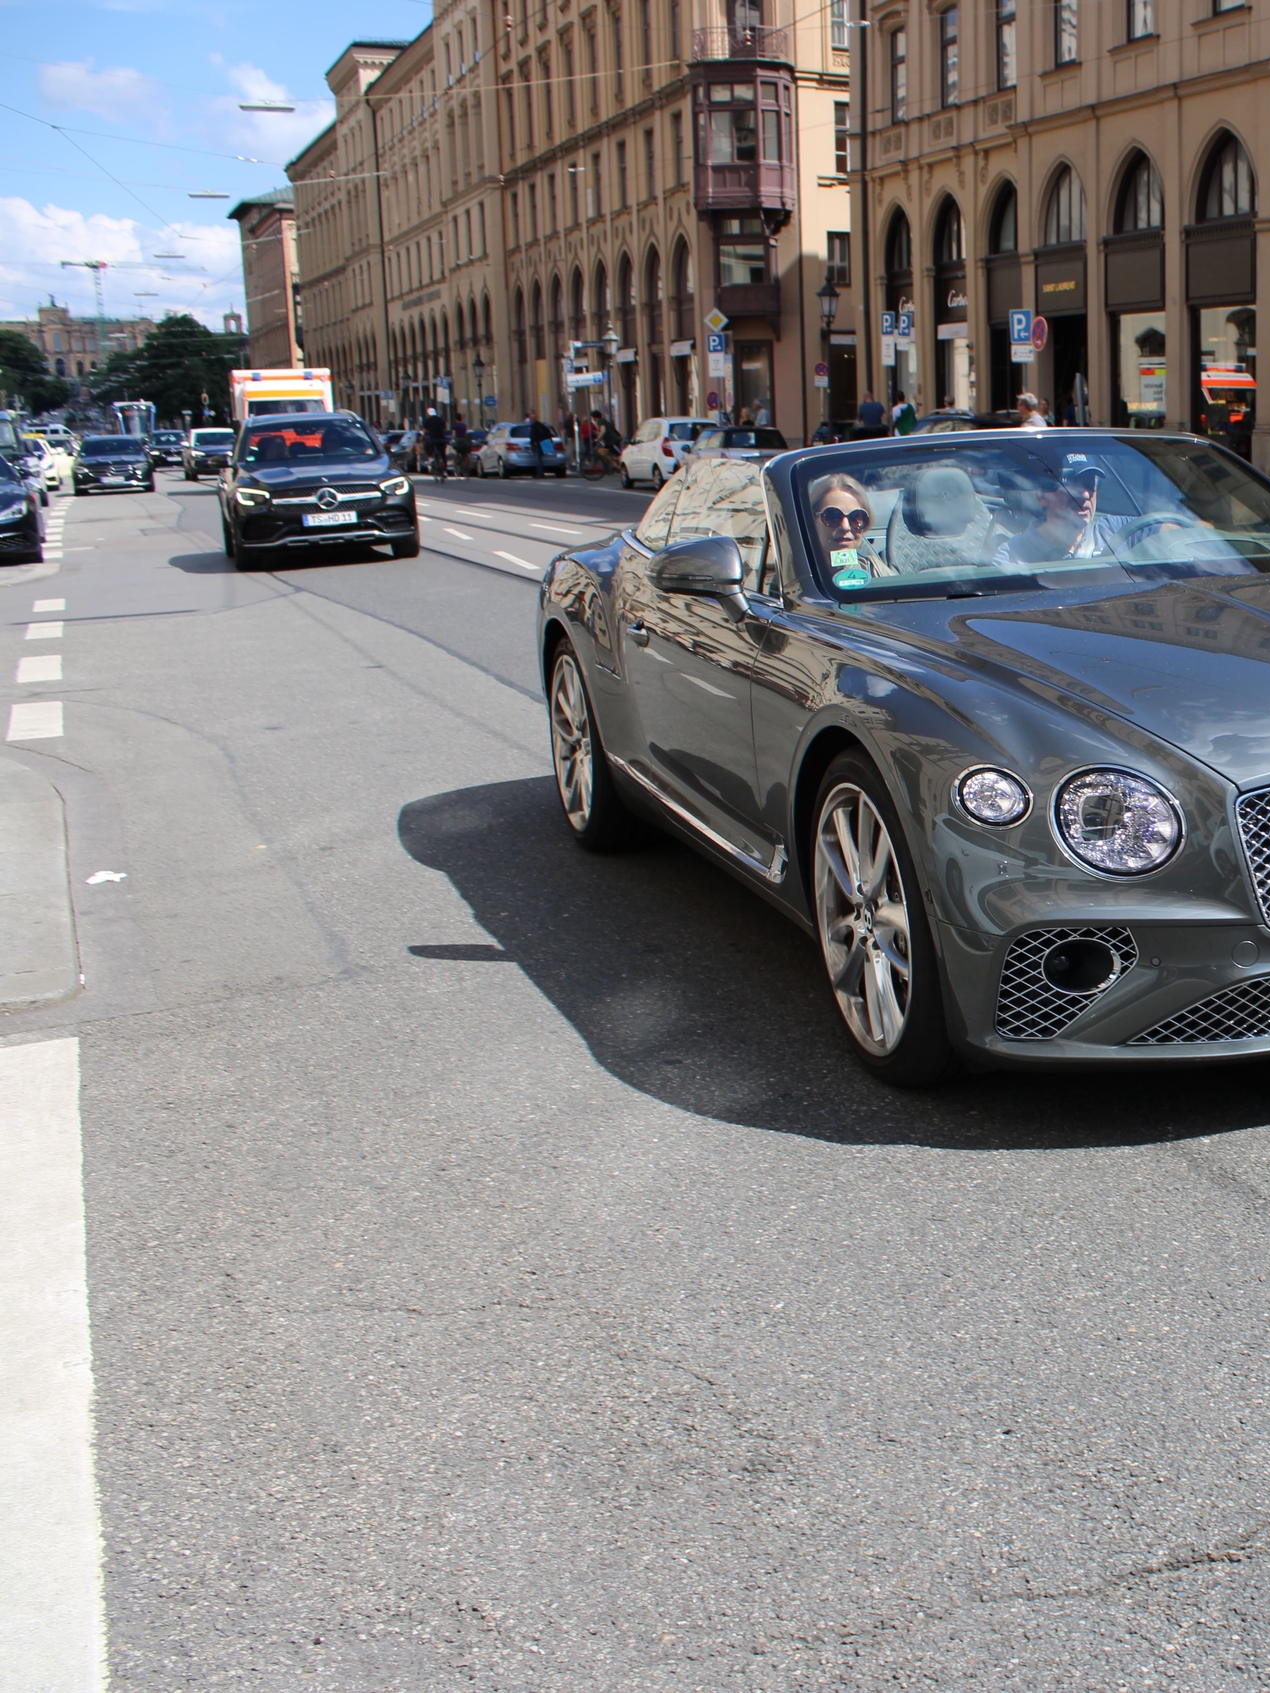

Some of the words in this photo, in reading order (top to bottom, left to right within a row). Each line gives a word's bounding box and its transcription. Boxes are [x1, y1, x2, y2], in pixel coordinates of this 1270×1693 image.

[883, 315, 891, 333] P
[1013, 314, 1026, 339] P
[709, 335, 719, 351] P
[311, 514, 323, 524] TS
[342, 513, 352, 521] 11
[847, 571, 857, 579] 4
